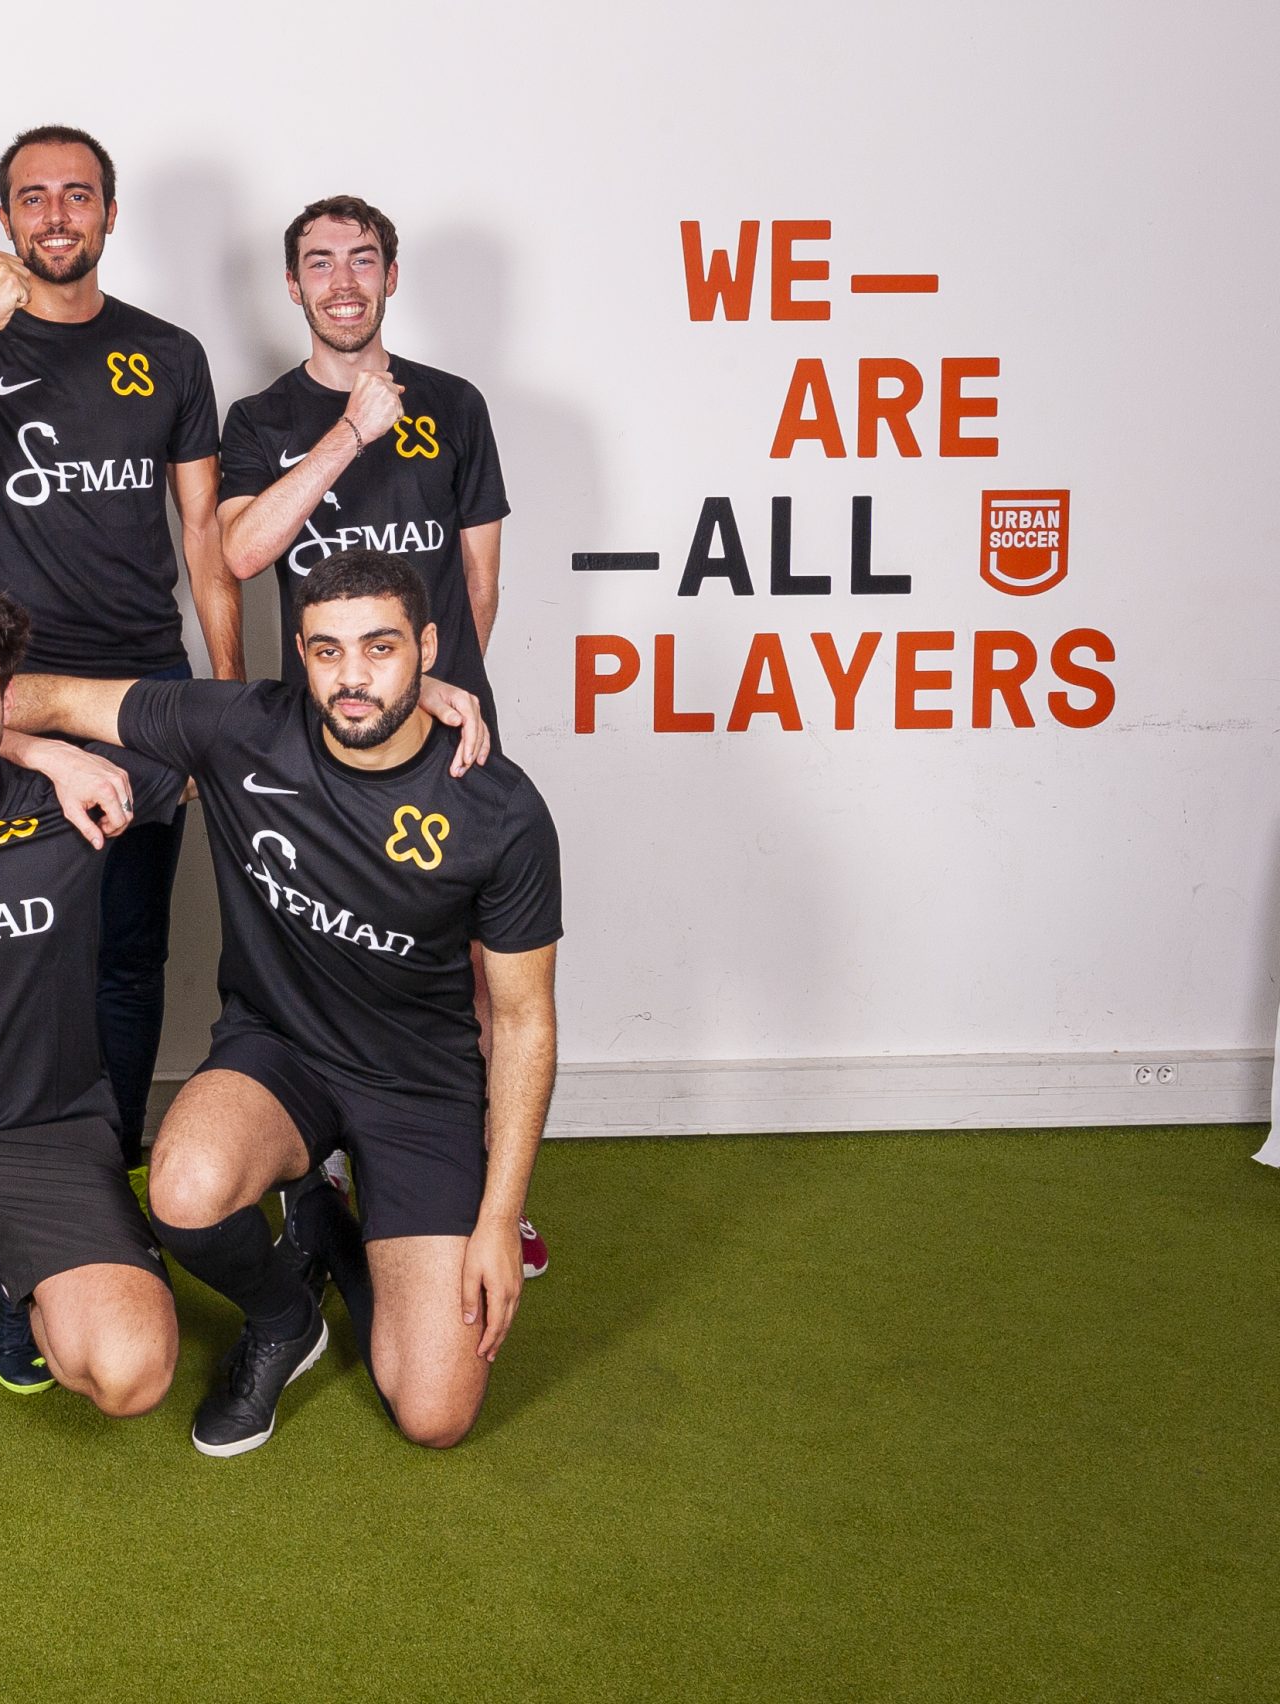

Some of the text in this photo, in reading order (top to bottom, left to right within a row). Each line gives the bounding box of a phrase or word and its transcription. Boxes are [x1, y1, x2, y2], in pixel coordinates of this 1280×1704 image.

[770, 358, 1000, 459] ARE
[6, 421, 154, 507] SFMAD
[989, 531, 1059, 548] SOCCER
[990, 510, 1060, 529] URBAN
[575, 628, 1116, 734] PLAYERS
